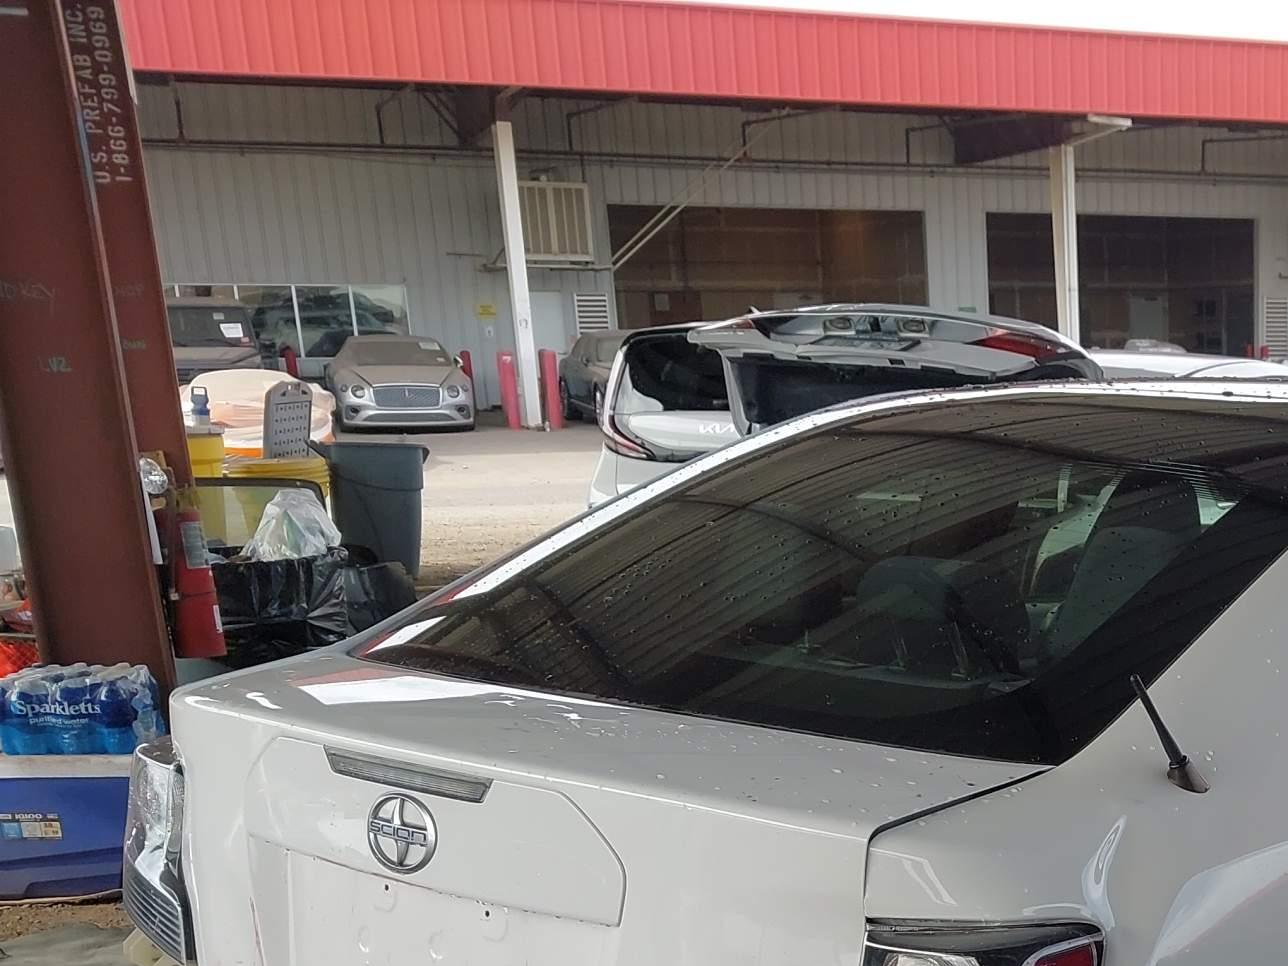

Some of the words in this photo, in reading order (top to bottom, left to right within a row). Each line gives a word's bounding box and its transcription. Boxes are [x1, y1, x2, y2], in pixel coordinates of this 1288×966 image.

[65, 3, 87, 43] INC.
[73, 54, 104, 134] PREFAB
[86, 6, 133, 182] 1-866-799-0969
[90, 145, 112, 184] U.S.
[15, 700, 102, 718] Sparkletts
[370, 819, 428, 844] SCION
